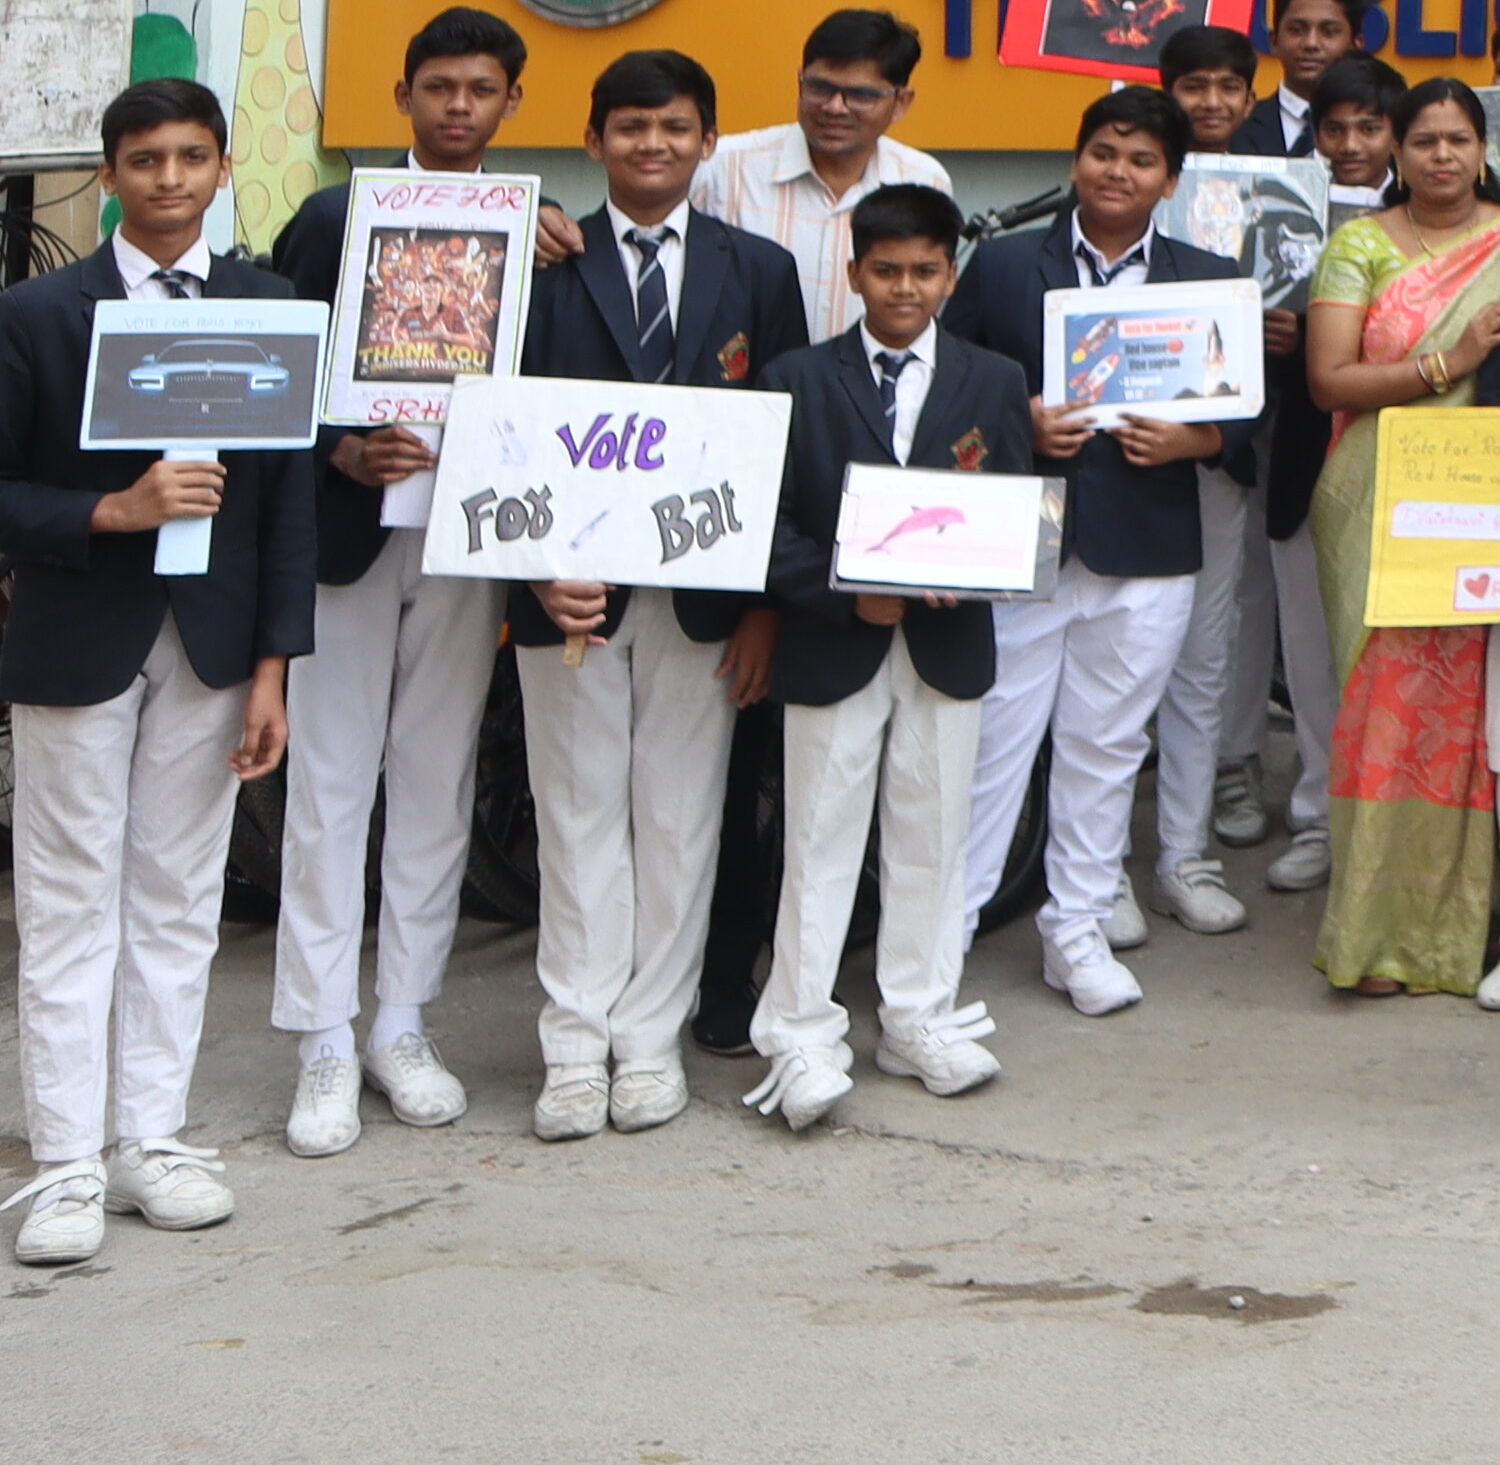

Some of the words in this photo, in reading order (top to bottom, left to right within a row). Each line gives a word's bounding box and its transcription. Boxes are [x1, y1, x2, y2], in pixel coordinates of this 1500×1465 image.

[372, 186, 450, 209] VOTE
[456, 186, 526, 210] FOR
[358, 343, 438, 363] THANK
[443, 343, 487, 365] YOU
[369, 400, 442, 422] SRH
[556, 412, 668, 471] Vote
[461, 484, 555, 554] For
[651, 480, 742, 565] Bat
